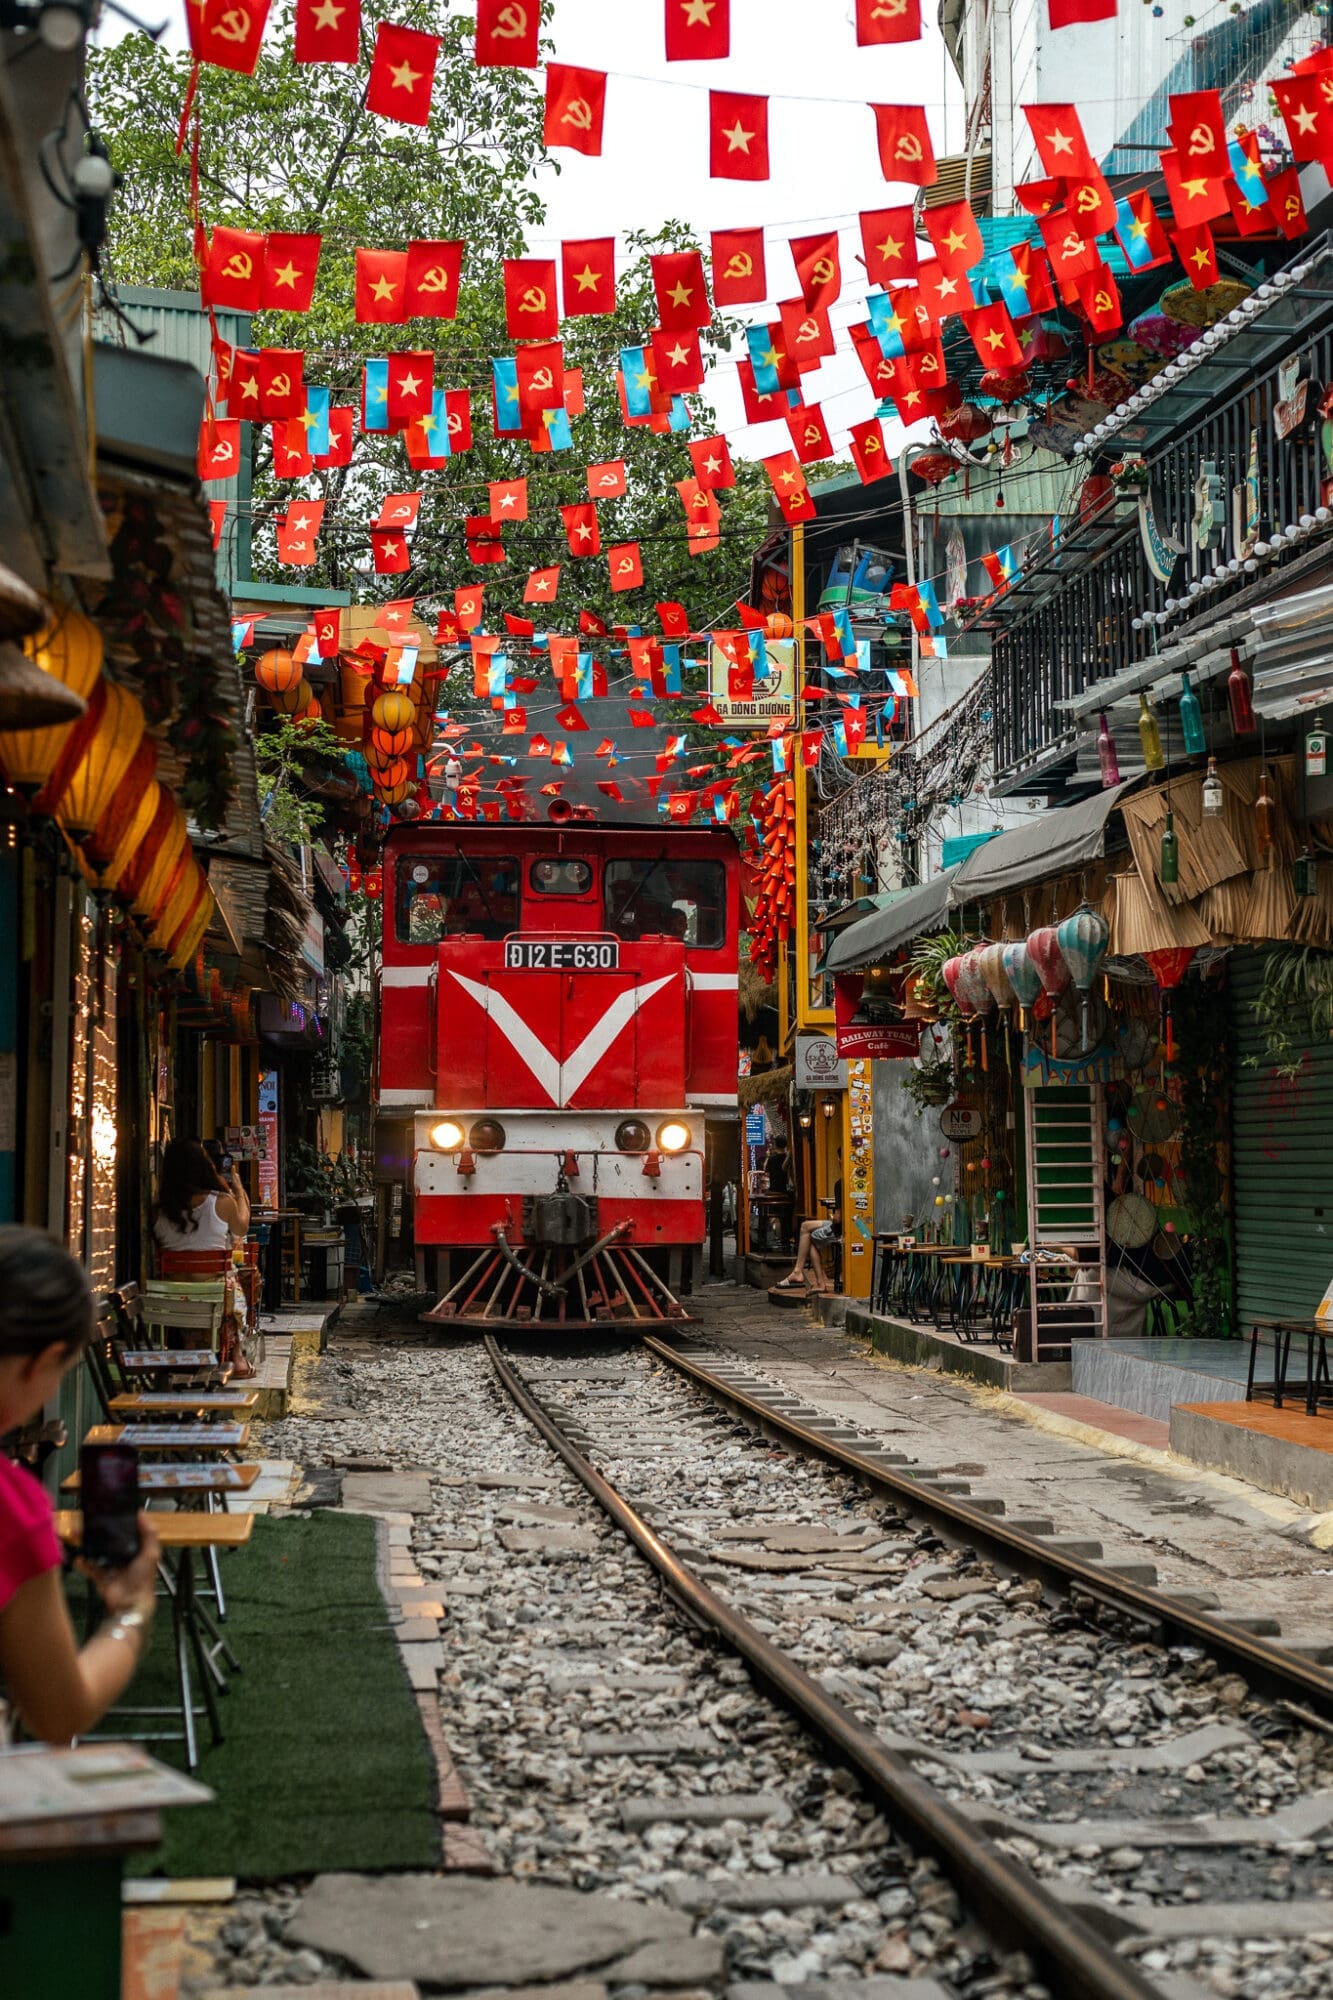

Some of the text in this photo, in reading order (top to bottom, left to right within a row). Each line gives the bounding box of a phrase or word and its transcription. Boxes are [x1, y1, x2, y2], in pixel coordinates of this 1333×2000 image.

[716, 703, 728, 714] GA
[840, 1030, 885, 1044] RAILWAY
[950, 1111, 972, 1123] NO
